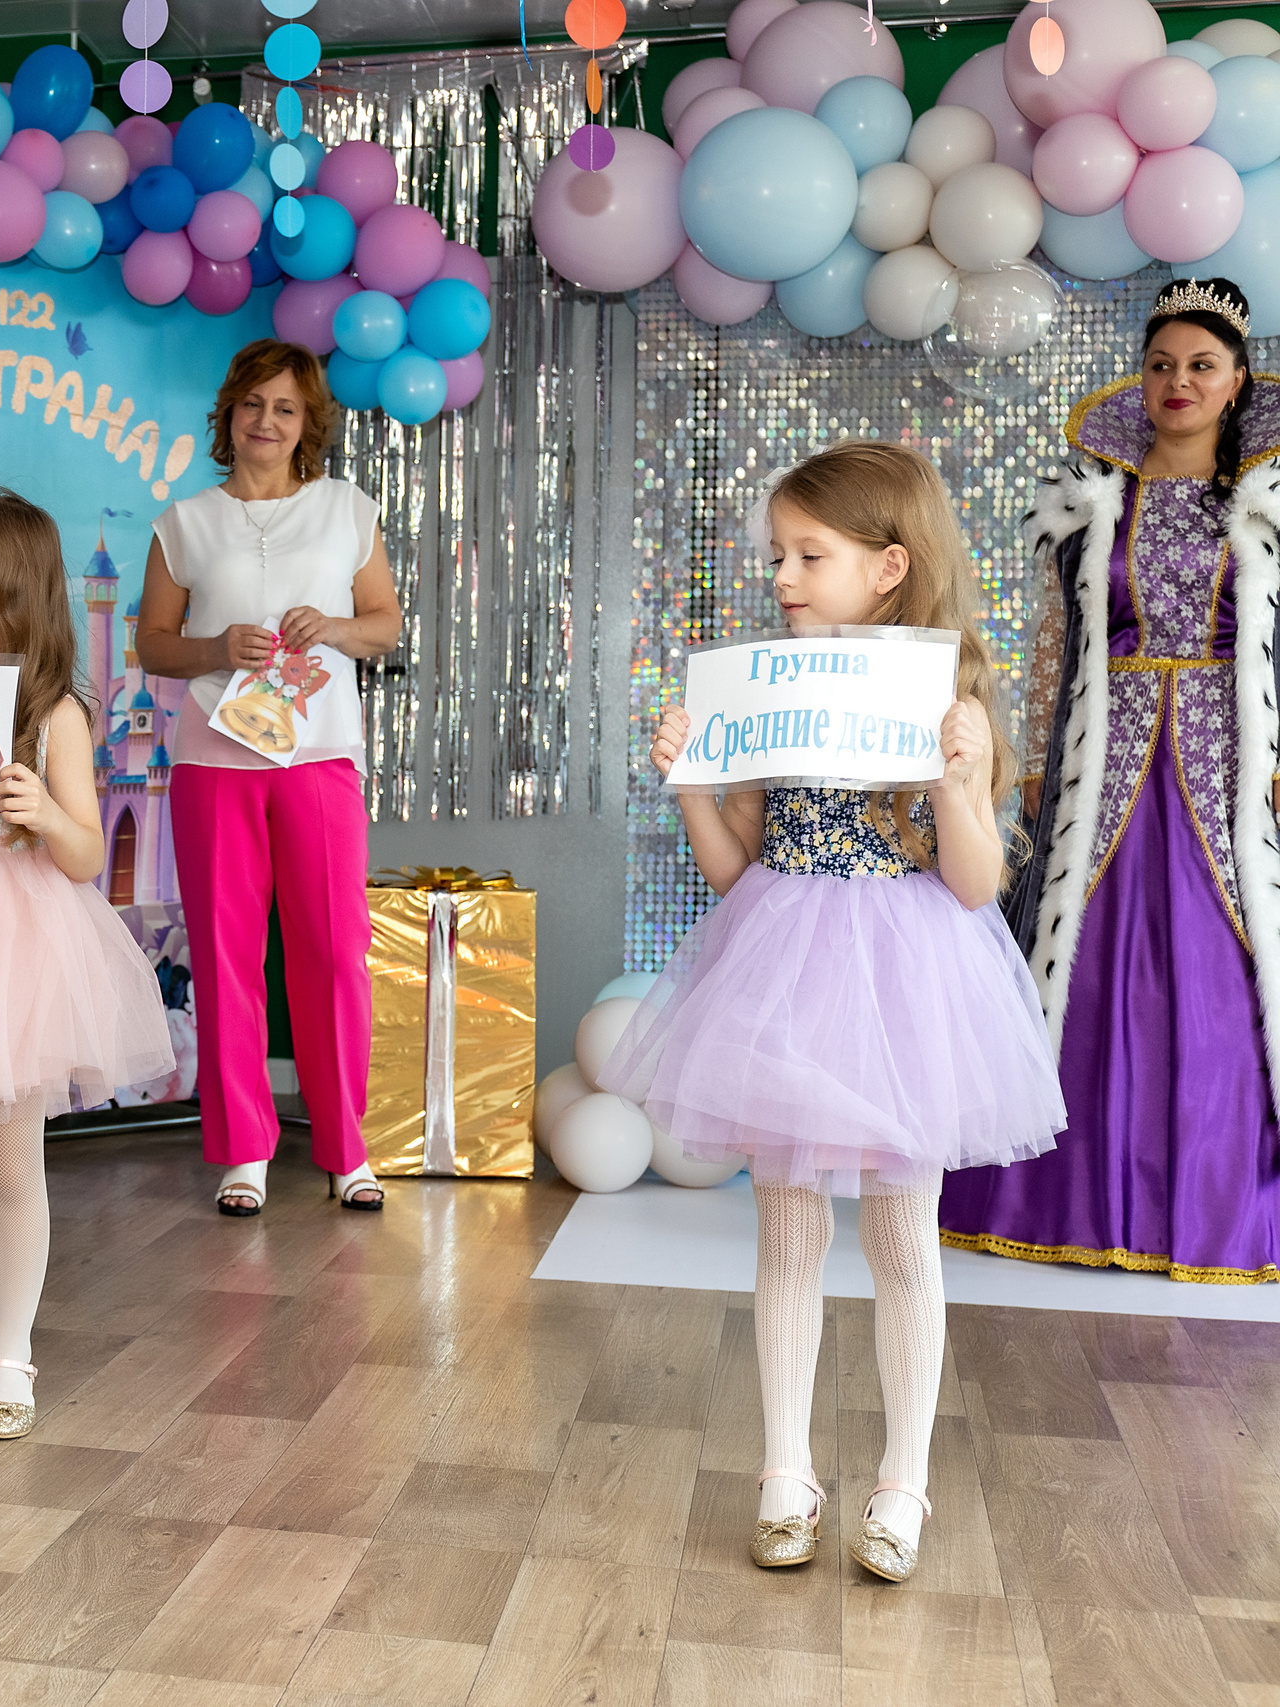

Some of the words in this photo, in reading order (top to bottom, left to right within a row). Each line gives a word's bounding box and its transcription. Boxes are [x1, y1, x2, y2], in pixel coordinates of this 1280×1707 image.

[748, 648, 869, 685] Группа
[686, 708, 830, 773] «Средние
[835, 710, 938, 760] дети»
